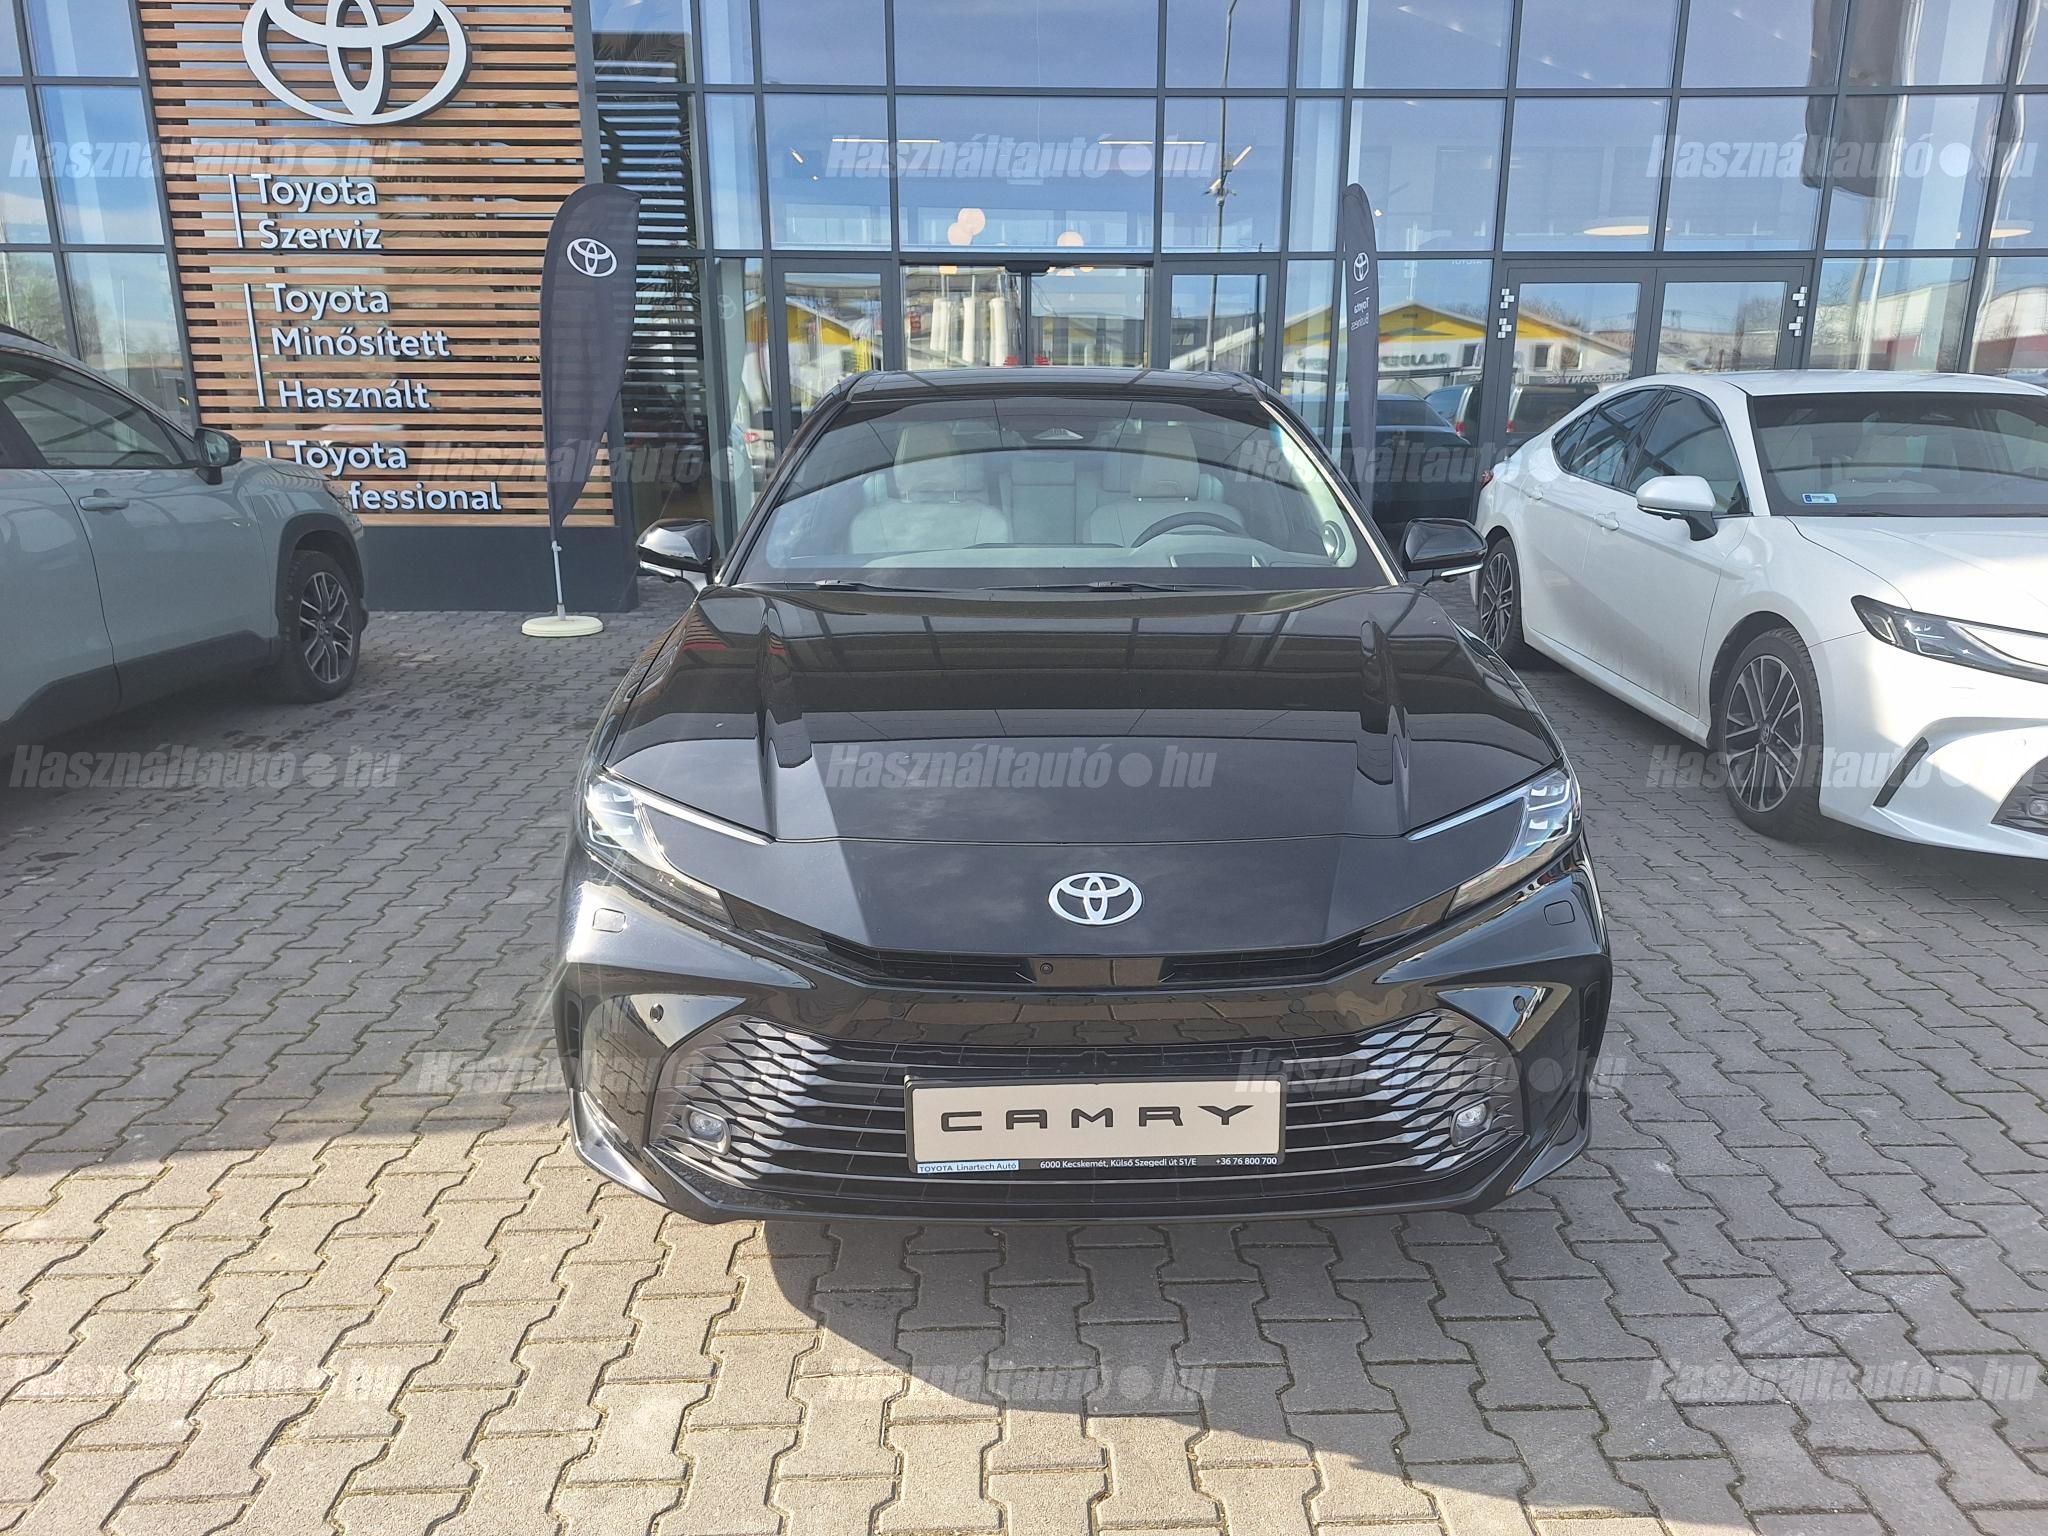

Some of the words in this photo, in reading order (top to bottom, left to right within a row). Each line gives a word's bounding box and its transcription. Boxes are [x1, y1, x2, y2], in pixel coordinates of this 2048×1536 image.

[251, 173, 378, 212] Toyota
[258, 219, 383, 249] Szerviz
[266, 283, 391, 321] Toyota
[271, 326, 452, 357] Minősített
[278, 379, 432, 409] Használt
[287, 440, 408, 477] Toyota
[349, 481, 503, 512] fessional
[941, 1104, 1255, 1132] CAMRY
[919, 1165, 953, 1173] TOYOTA
[956, 1163, 995, 1171] Linartech
[996, 1162, 1017, 1170] Autó
[1040, 1161, 1060, 1169] 6000
[1062, 1160, 1109, 1168] Kecskemét,
[1110, 1158, 1133, 1167] Külső
[1134, 1158, 1167, 1168] Szegedi
[1168, 1158, 1178, 1166] út
[1178, 1158, 1197, 1166] 51/E
[1215, 1158, 1231, 1166] +36
[1261, 1157, 1277, 1165] 700
